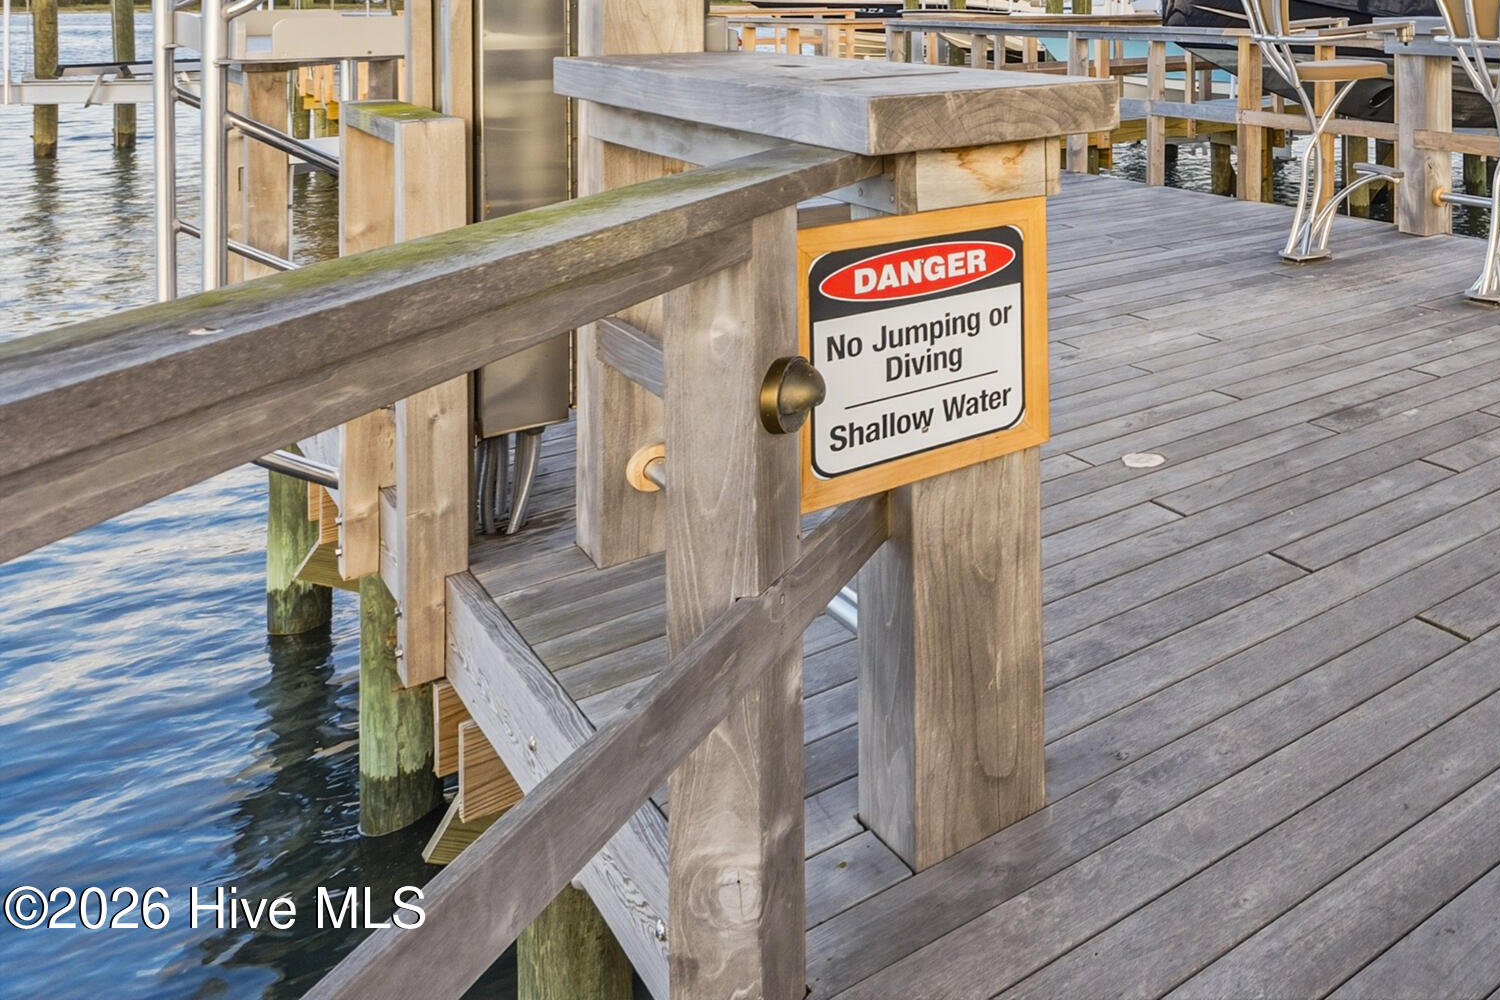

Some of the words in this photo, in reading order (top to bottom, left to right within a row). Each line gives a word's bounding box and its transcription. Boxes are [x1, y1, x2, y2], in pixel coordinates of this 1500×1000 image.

[854, 248, 987, 295] DANGER
[826, 334, 862, 362] No
[872, 311, 980, 352] Jumping
[989, 304, 1012, 327] or
[885, 346, 963, 383] Diving
[829, 407, 934, 452] Shallow
[942, 387, 1012, 423] Water
